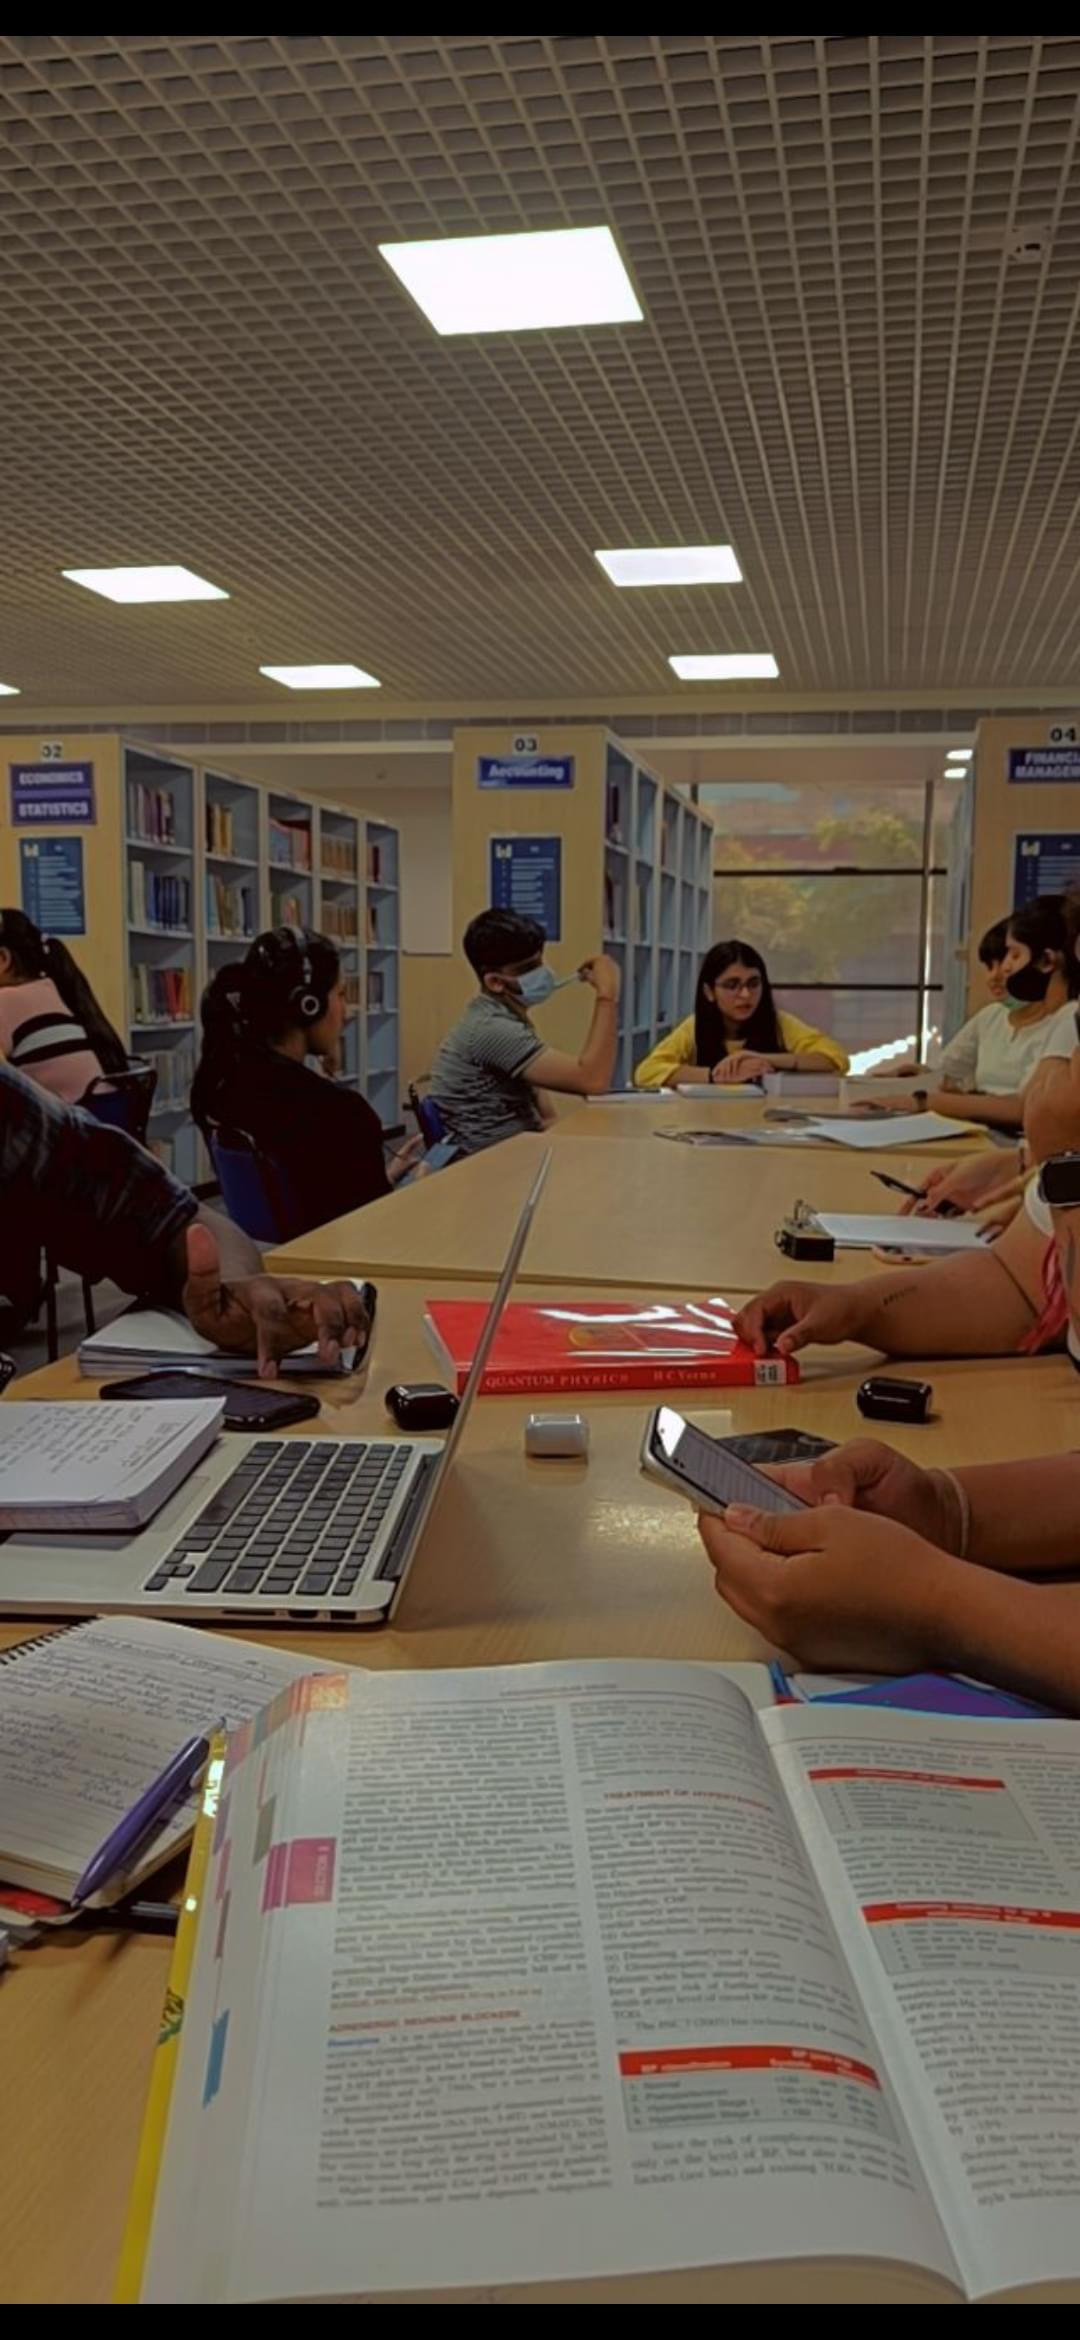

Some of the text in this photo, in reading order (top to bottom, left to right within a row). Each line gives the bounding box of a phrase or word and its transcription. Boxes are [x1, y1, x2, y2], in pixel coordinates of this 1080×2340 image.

[1050, 728, 1077, 742] 04
[515, 738, 537, 750] 03
[19, 772, 84, 785] ECONOMICS
[488, 765, 564, 780] Accounting
[19, 802, 89, 817] STATISTICS
[485, 1373, 555, 1389] QUANTUM
[559, 1372, 630, 1386] PHYSICS
[460, 2009, 522, 2022] BLOCKERS
